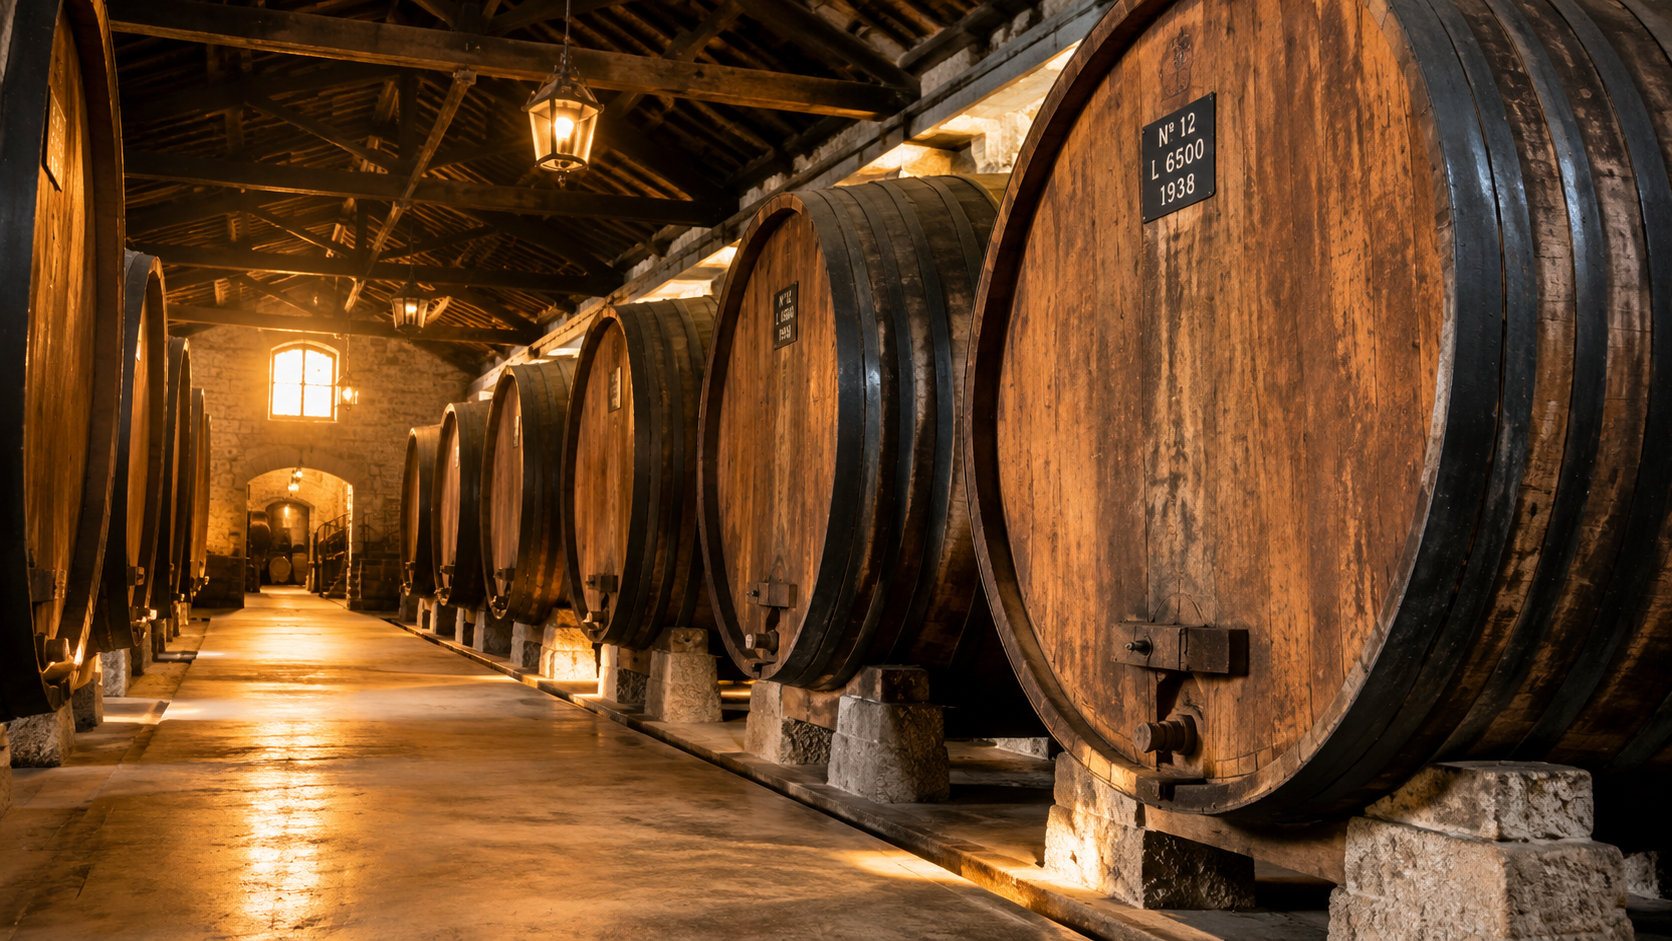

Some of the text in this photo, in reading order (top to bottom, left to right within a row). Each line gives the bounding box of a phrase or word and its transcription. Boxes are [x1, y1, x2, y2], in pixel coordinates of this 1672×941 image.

[1180, 112, 1196, 138] 12
[1151, 138, 1204, 180] L 6500
[1160, 173, 1195, 206] 1938
